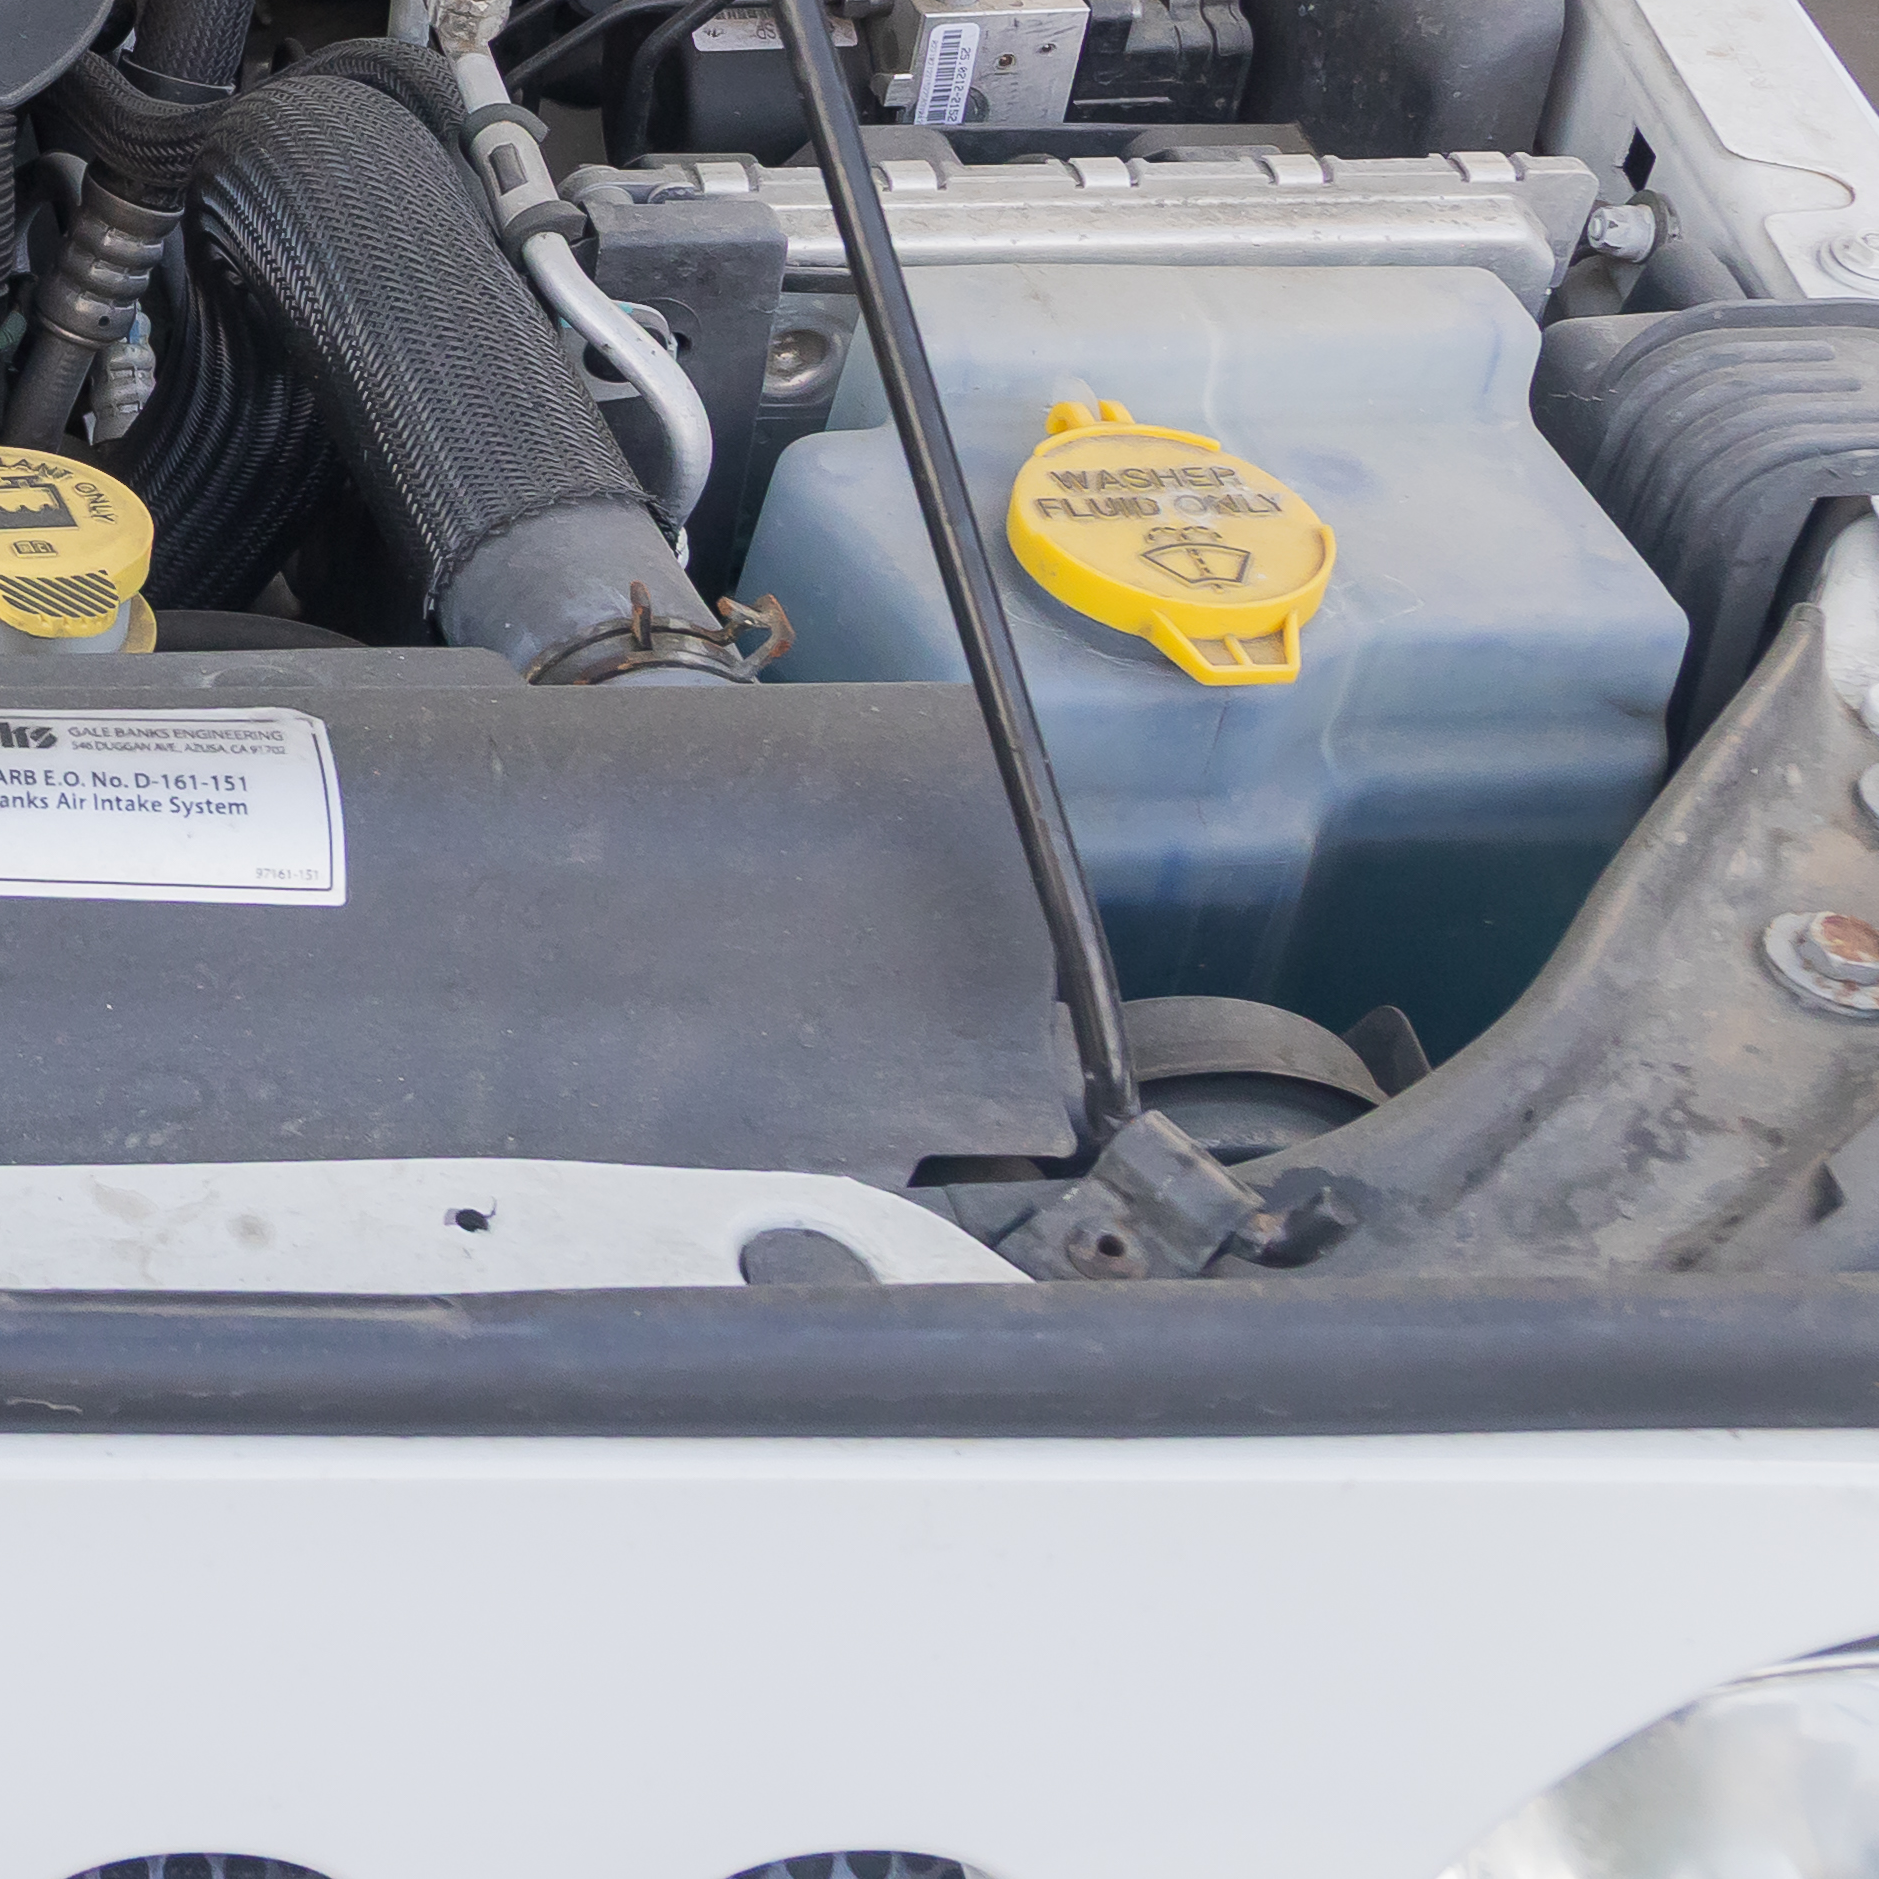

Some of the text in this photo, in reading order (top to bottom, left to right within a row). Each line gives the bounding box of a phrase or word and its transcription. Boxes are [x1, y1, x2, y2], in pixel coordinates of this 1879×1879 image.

[1047, 464, 1247, 495] WASHER
[74, 481, 119, 525] ONLY
[1034, 492, 1288, 524] FLUID ONLY
[67, 726, 284, 741] GALE BANKS ENGINEERING
[95, 740, 151, 752] DUGGAN
[230, 743, 248, 754] CA
[44, 769, 86, 788] E.O.
[92, 771, 130, 789] No.
[135, 773, 249, 793] D-161-151
[56, 792, 86, 811] Air
[93, 793, 163, 813] Intake
[170, 796, 250, 818] System
